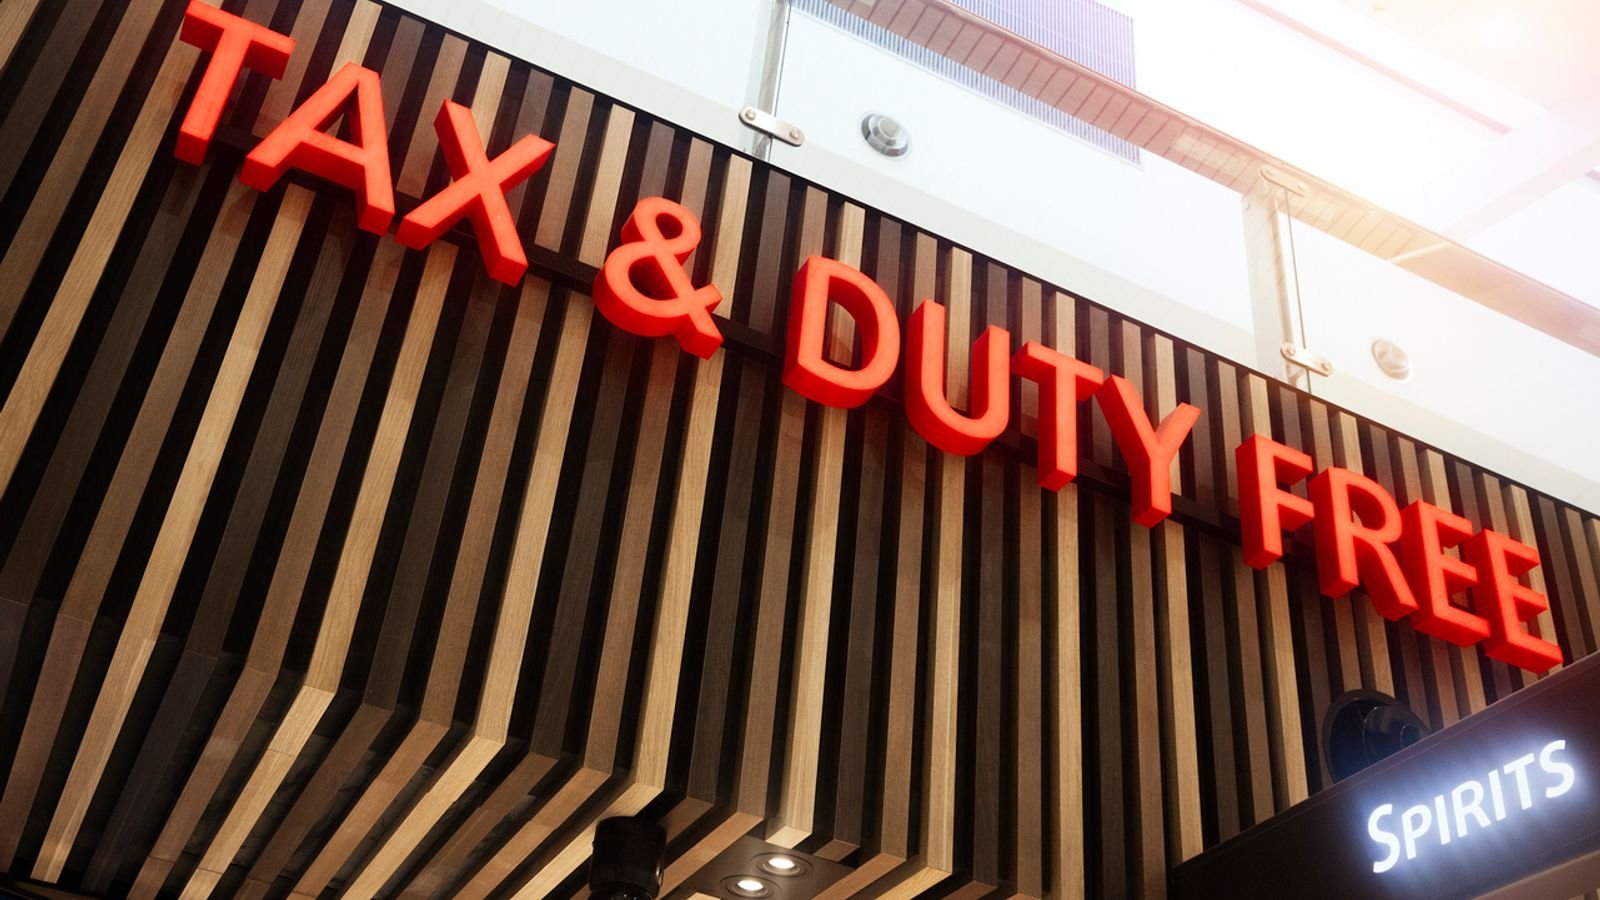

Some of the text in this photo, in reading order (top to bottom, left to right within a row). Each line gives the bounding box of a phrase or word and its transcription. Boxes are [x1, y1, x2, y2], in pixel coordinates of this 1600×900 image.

[174, 0, 1564, 675] TAX & DUTY FREE
[1367, 739, 1576, 874] SPIRITS
